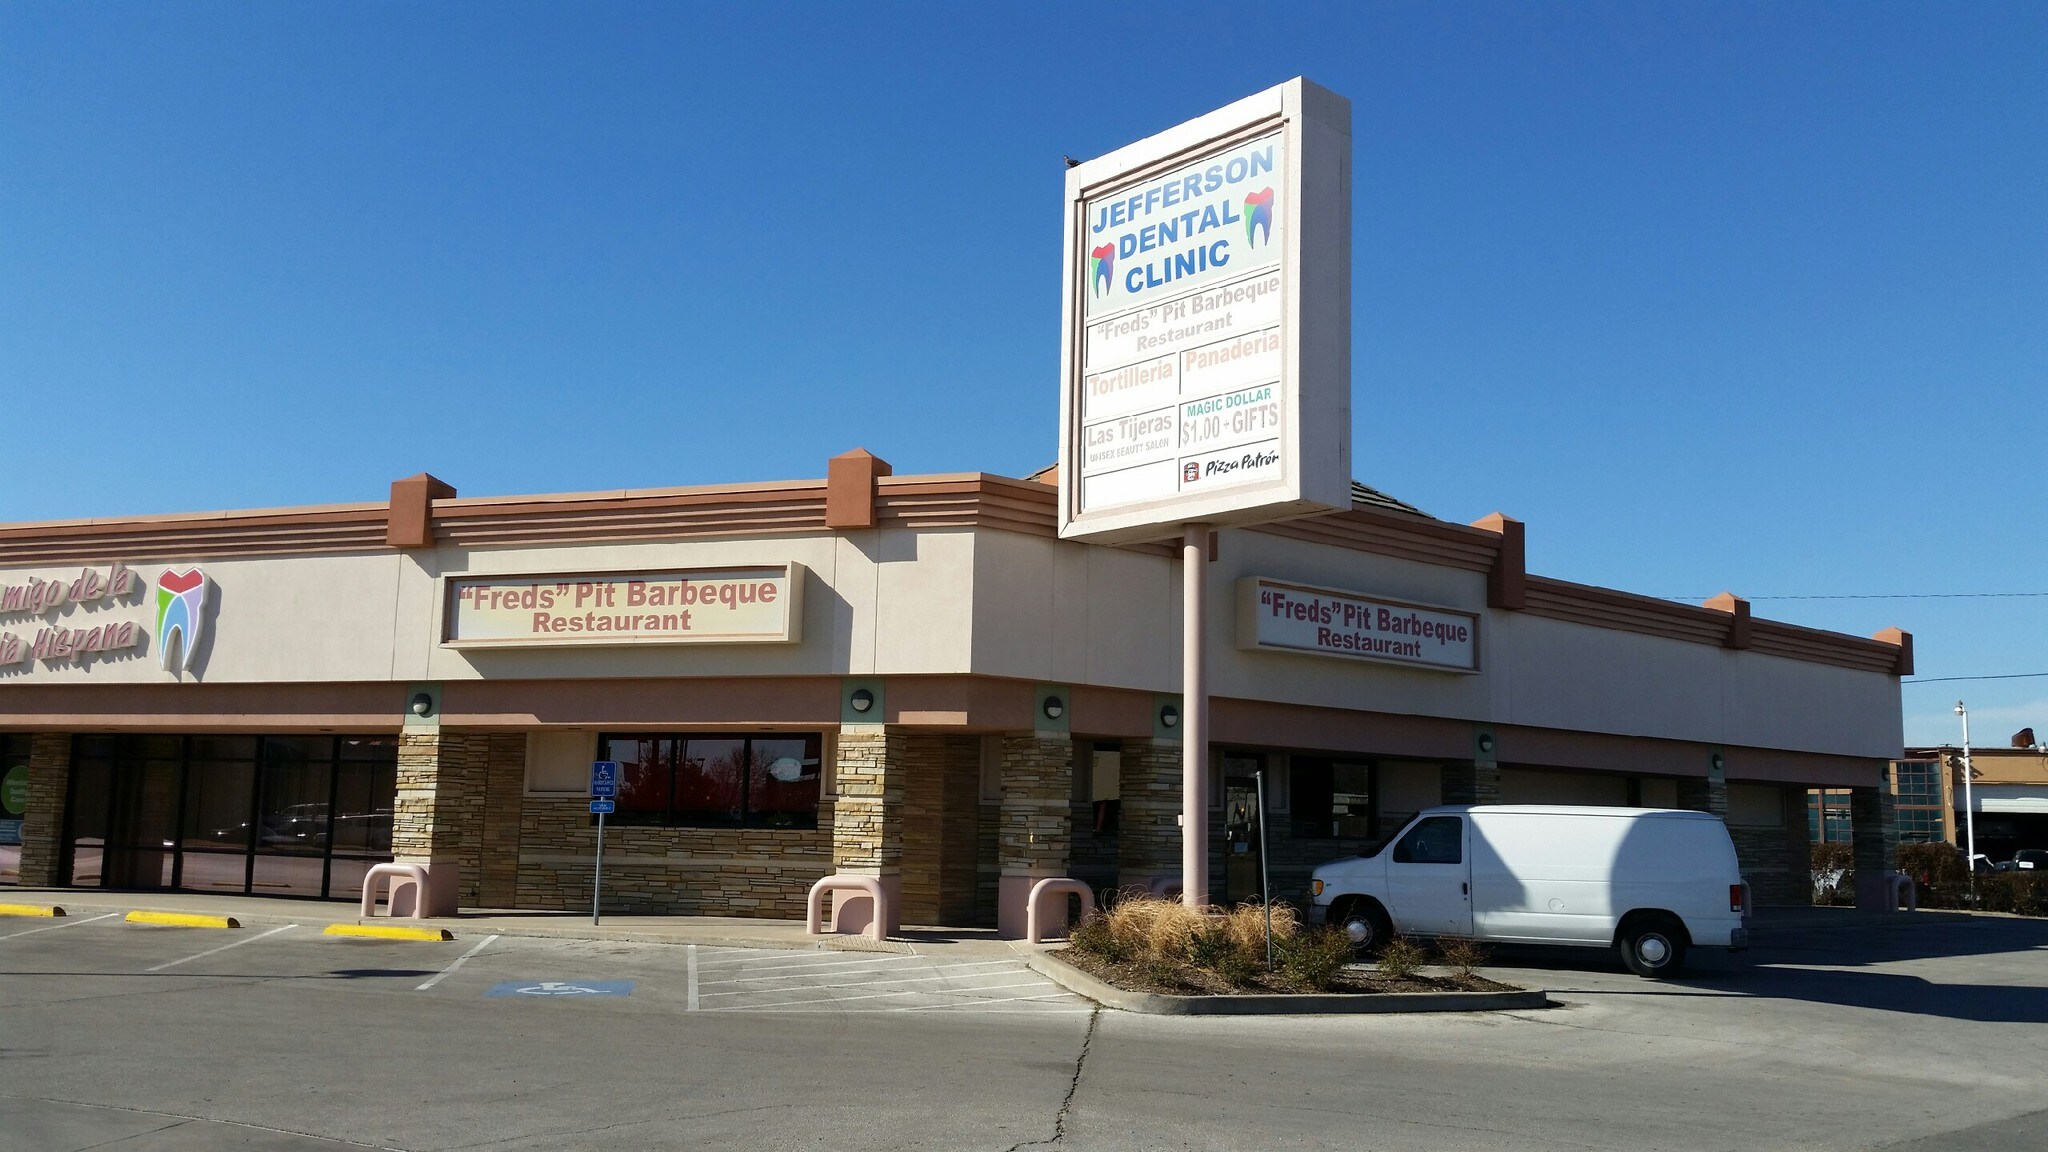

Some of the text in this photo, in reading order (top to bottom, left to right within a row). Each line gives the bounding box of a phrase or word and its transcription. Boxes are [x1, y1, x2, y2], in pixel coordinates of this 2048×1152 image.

[1092, 145, 1274, 234] JEFFERSON
[1119, 200, 1240, 260] DENTAL
[1125, 239, 1230, 294] CLINIC
[1097, 277, 1280, 340] “Freds” Pit Barbeque
[1136, 311, 1233, 352] Restaurant
[1185, 331, 1280, 372] Panaderia
[1089, 360, 1173, 396] Tortilleria
[1187, 387, 1272, 418] MAGIC DOLLAR
[1088, 415, 1172, 447] Las Tijeras
[1182, 415, 1220, 447] $1.00
[1232, 402, 1279, 434] GIFTS
[1090, 448, 1116, 462] UNISEX
[1145, 437, 1169, 451] SALON
[1206, 456, 1239, 477] Pizza
[0, 562, 132, 615] migo de la
[460, 579, 778, 611] “Freds” Pit Barbeque
[532, 609, 692, 633] Restaurant
[1261, 590, 1468, 645] “Freds” Pit Barbeque
[32, 622, 136, 662] Hispana
[1317, 626, 1422, 658] Restaurant
